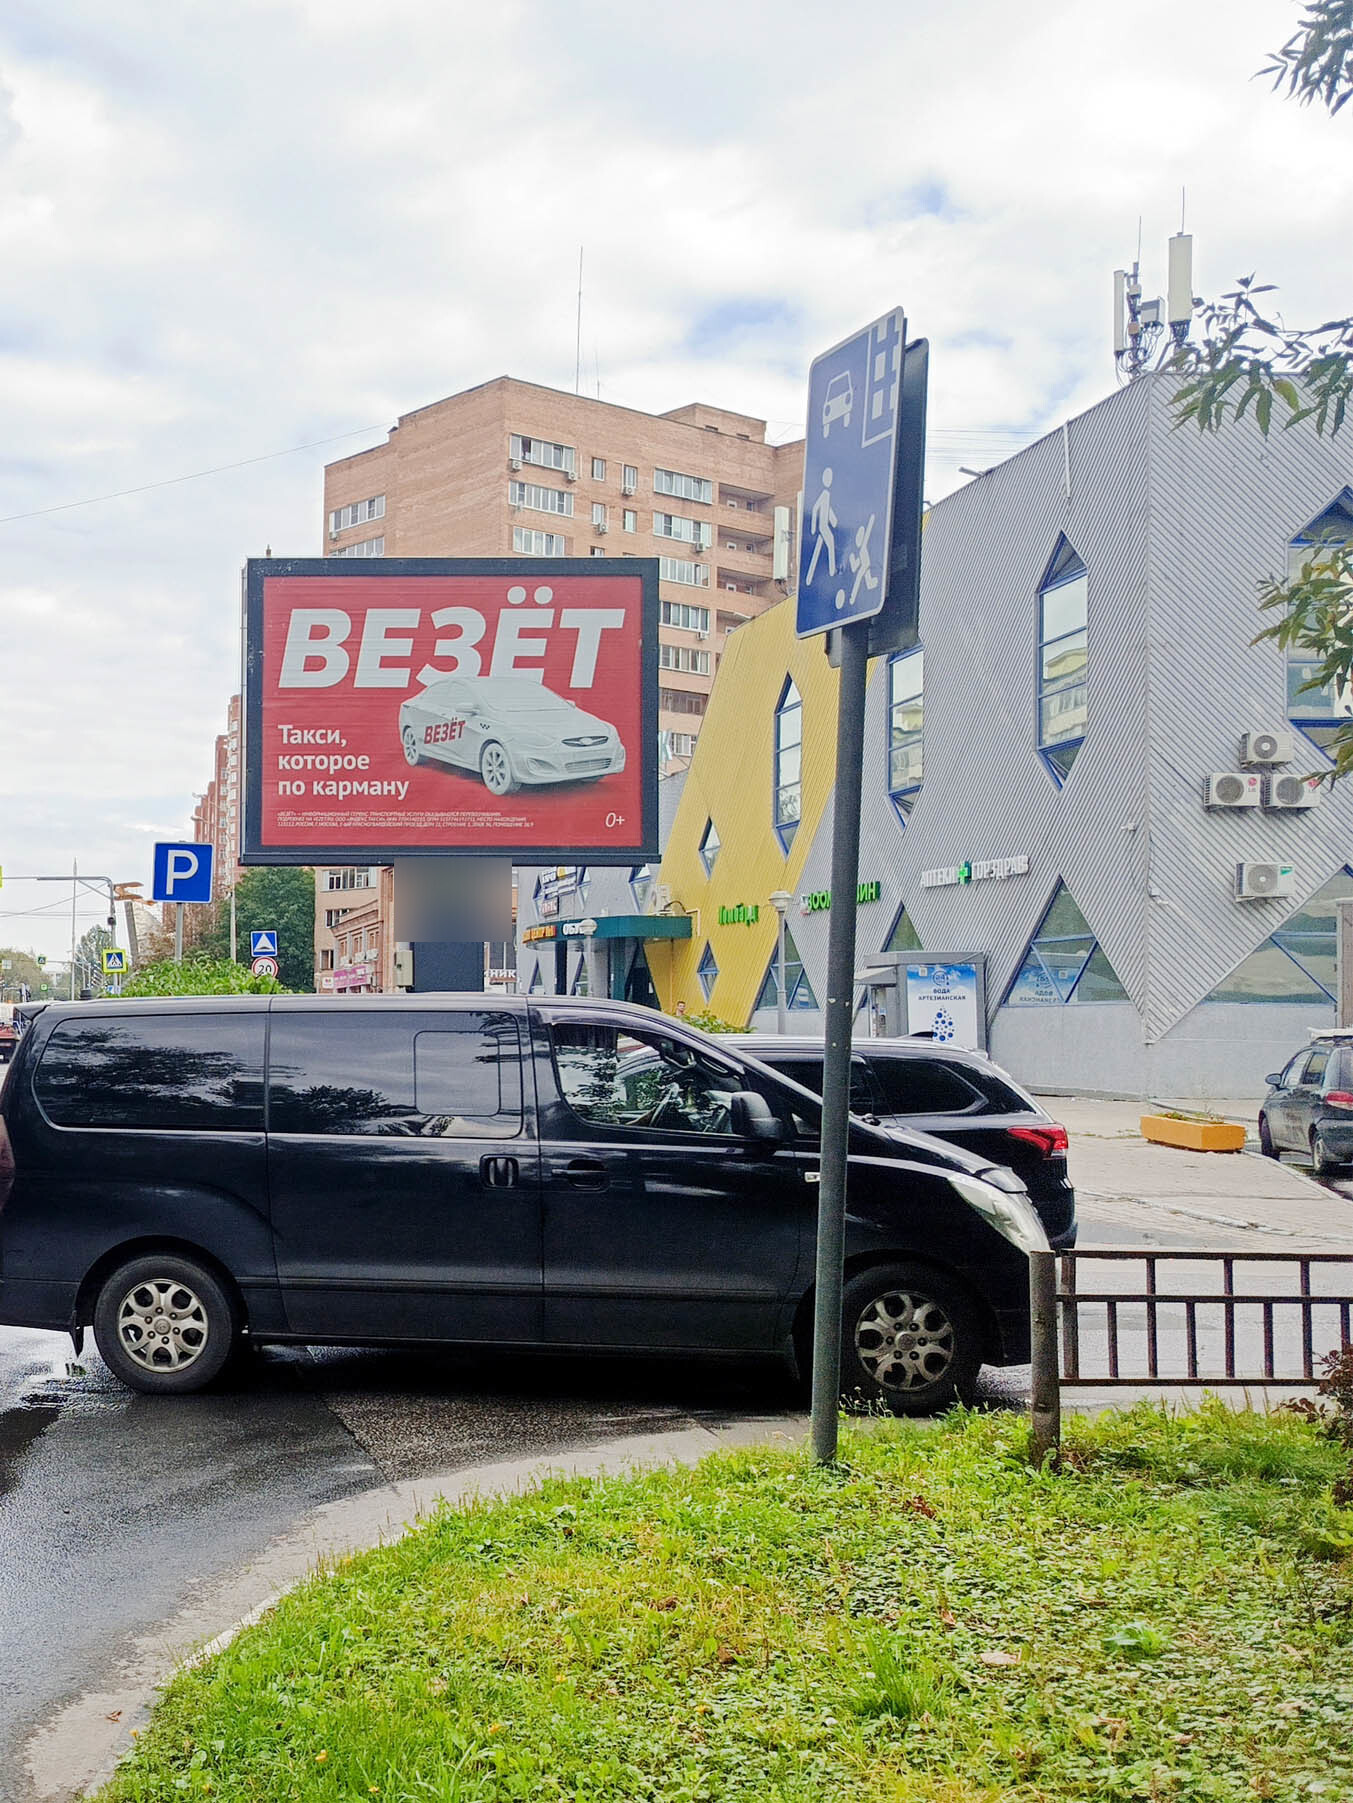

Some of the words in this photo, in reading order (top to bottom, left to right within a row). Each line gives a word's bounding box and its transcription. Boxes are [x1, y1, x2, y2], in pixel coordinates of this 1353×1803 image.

[278, 586, 626, 689] ВЕЗЁТ
[277, 725, 348, 748] Такси,
[423, 717, 466, 745] ВЕЗЁТ
[277, 754, 370, 773] которое
[277, 780, 306, 797] по
[312, 780, 410, 801] карману
[605, 812, 626, 829] 0+
[166, 850, 199, 896] P
[971, 855, 1029, 880] ГОРЗДРАВ
[258, 964, 272, 975] 20
